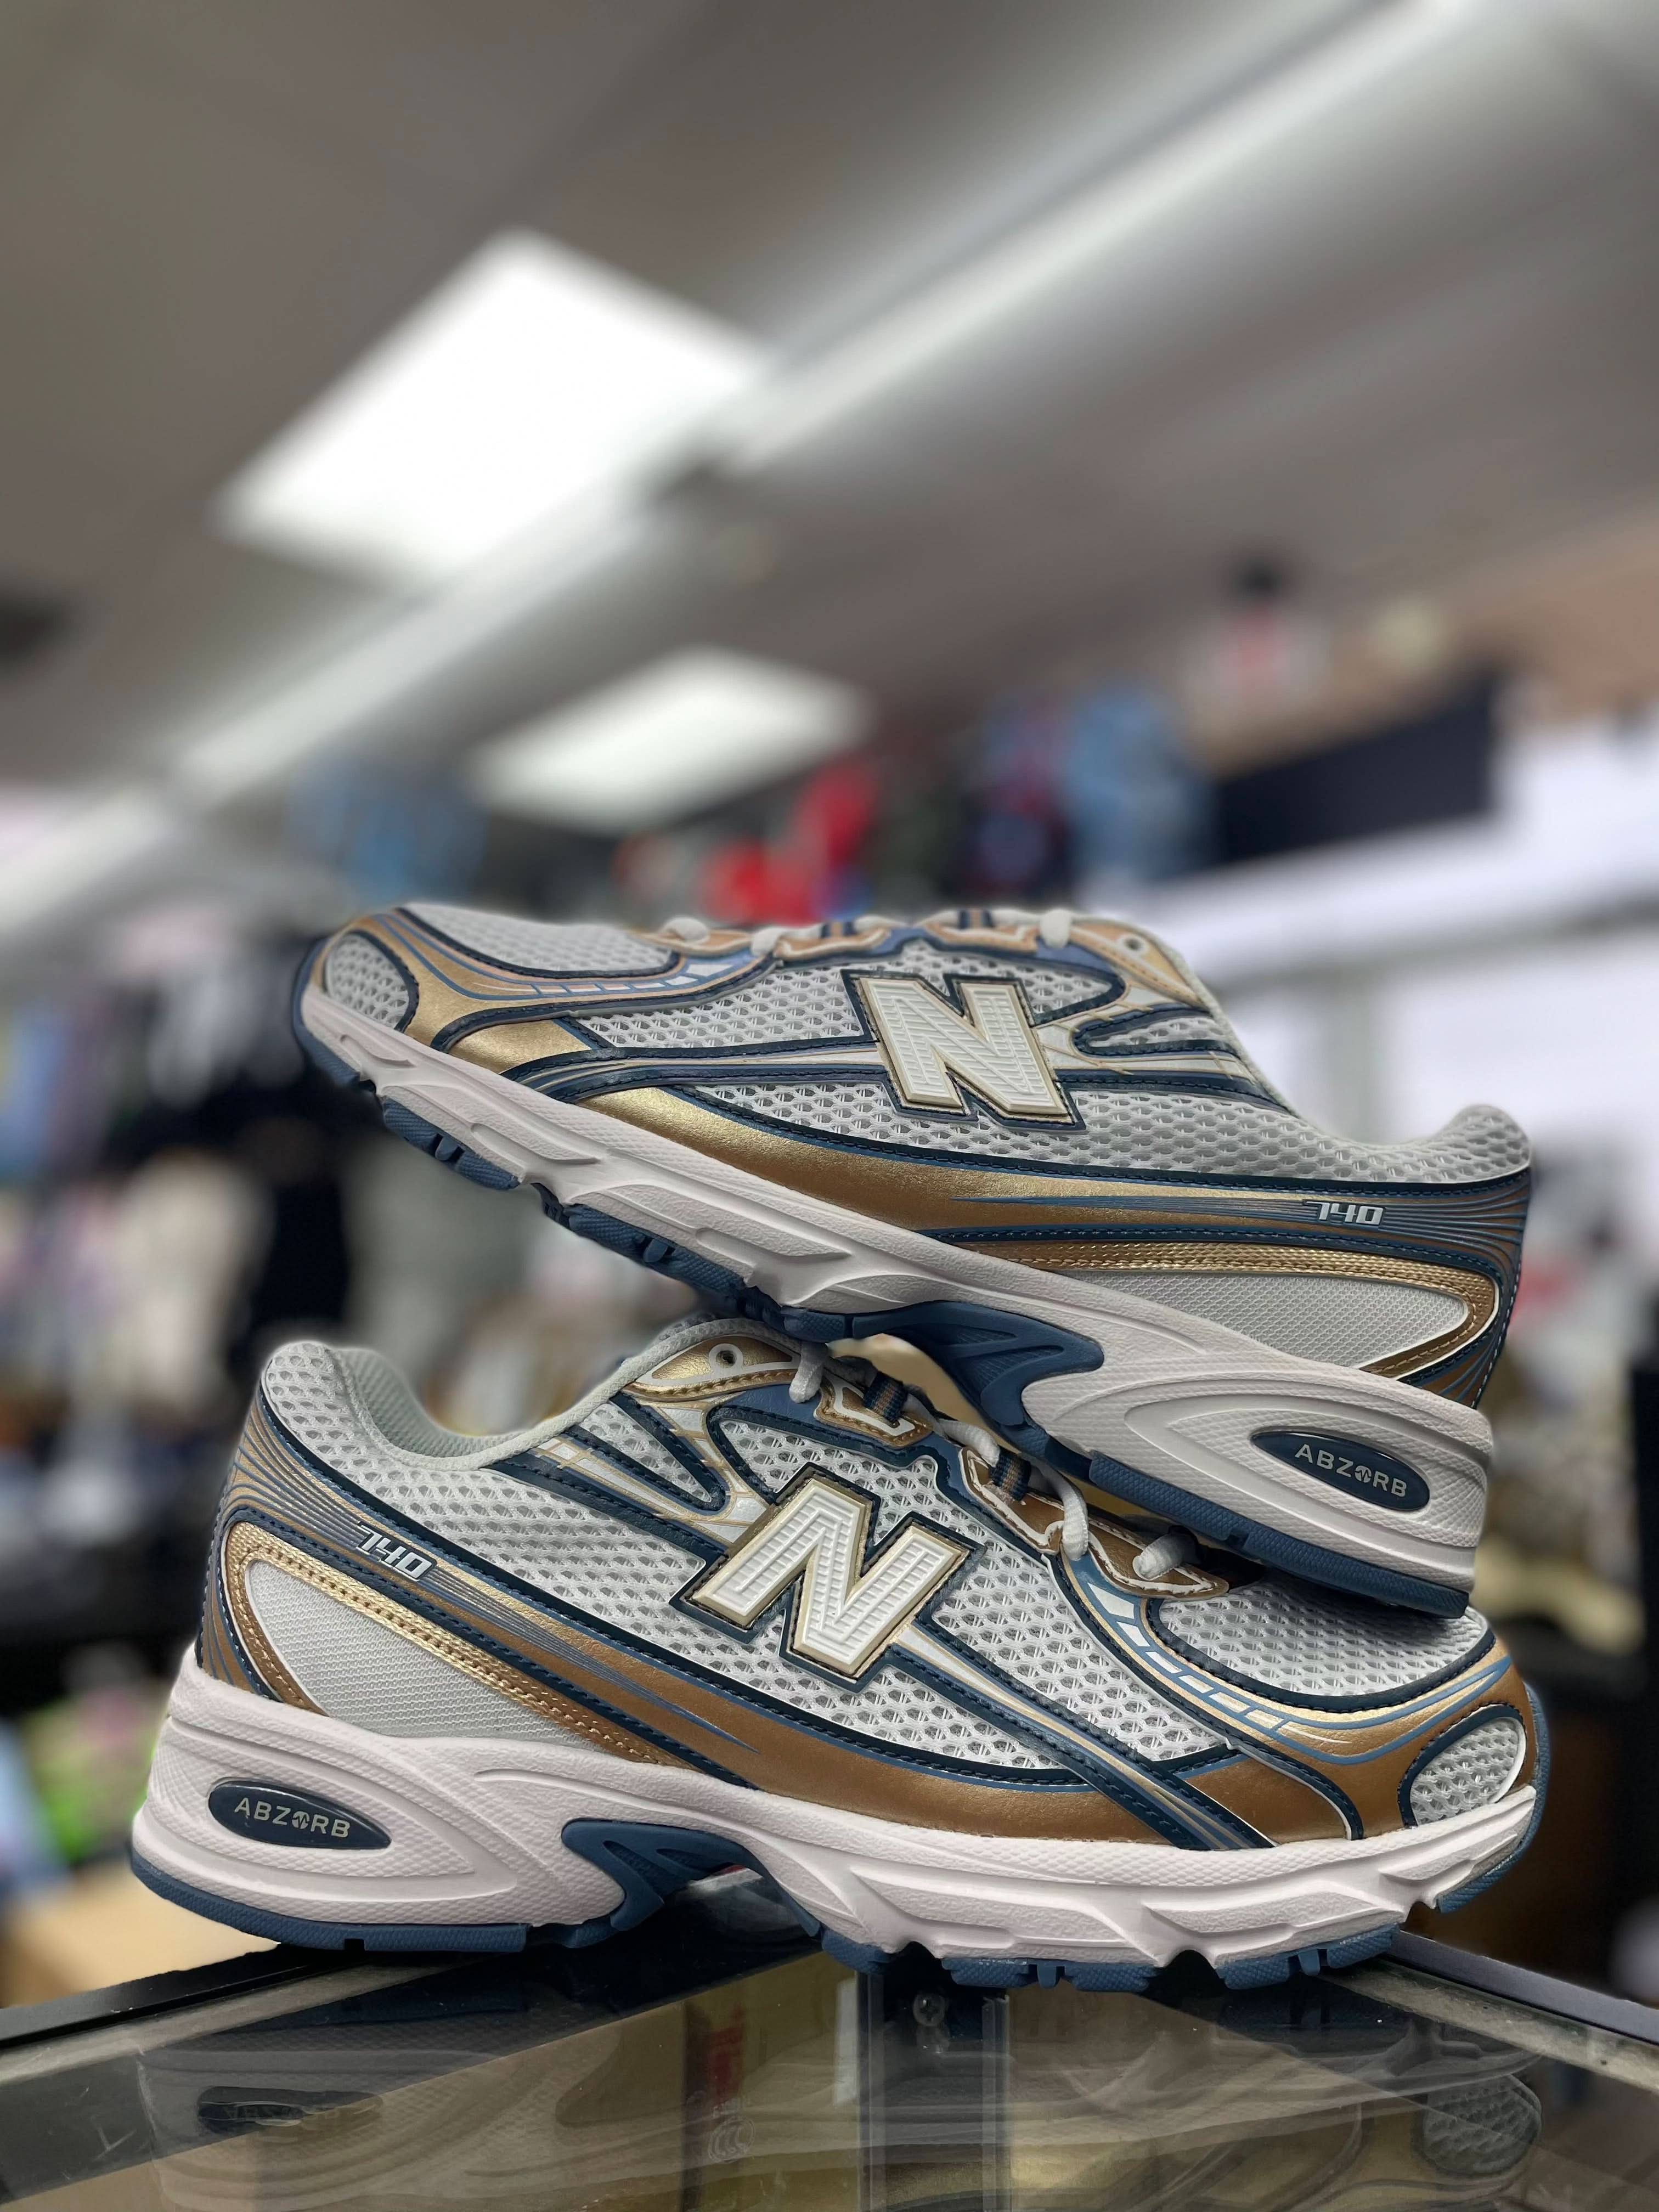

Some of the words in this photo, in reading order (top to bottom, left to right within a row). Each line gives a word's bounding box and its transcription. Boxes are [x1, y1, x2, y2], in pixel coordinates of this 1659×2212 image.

[860, 977, 1069, 1115] N
[1305, 1200, 1384, 1226] 740
[1294, 1443, 1408, 1498] ABZORB
[360, 1525, 433, 1579] 740
[693, 1478, 963, 1677] N
[234, 1797, 351, 1838] ABZORB
